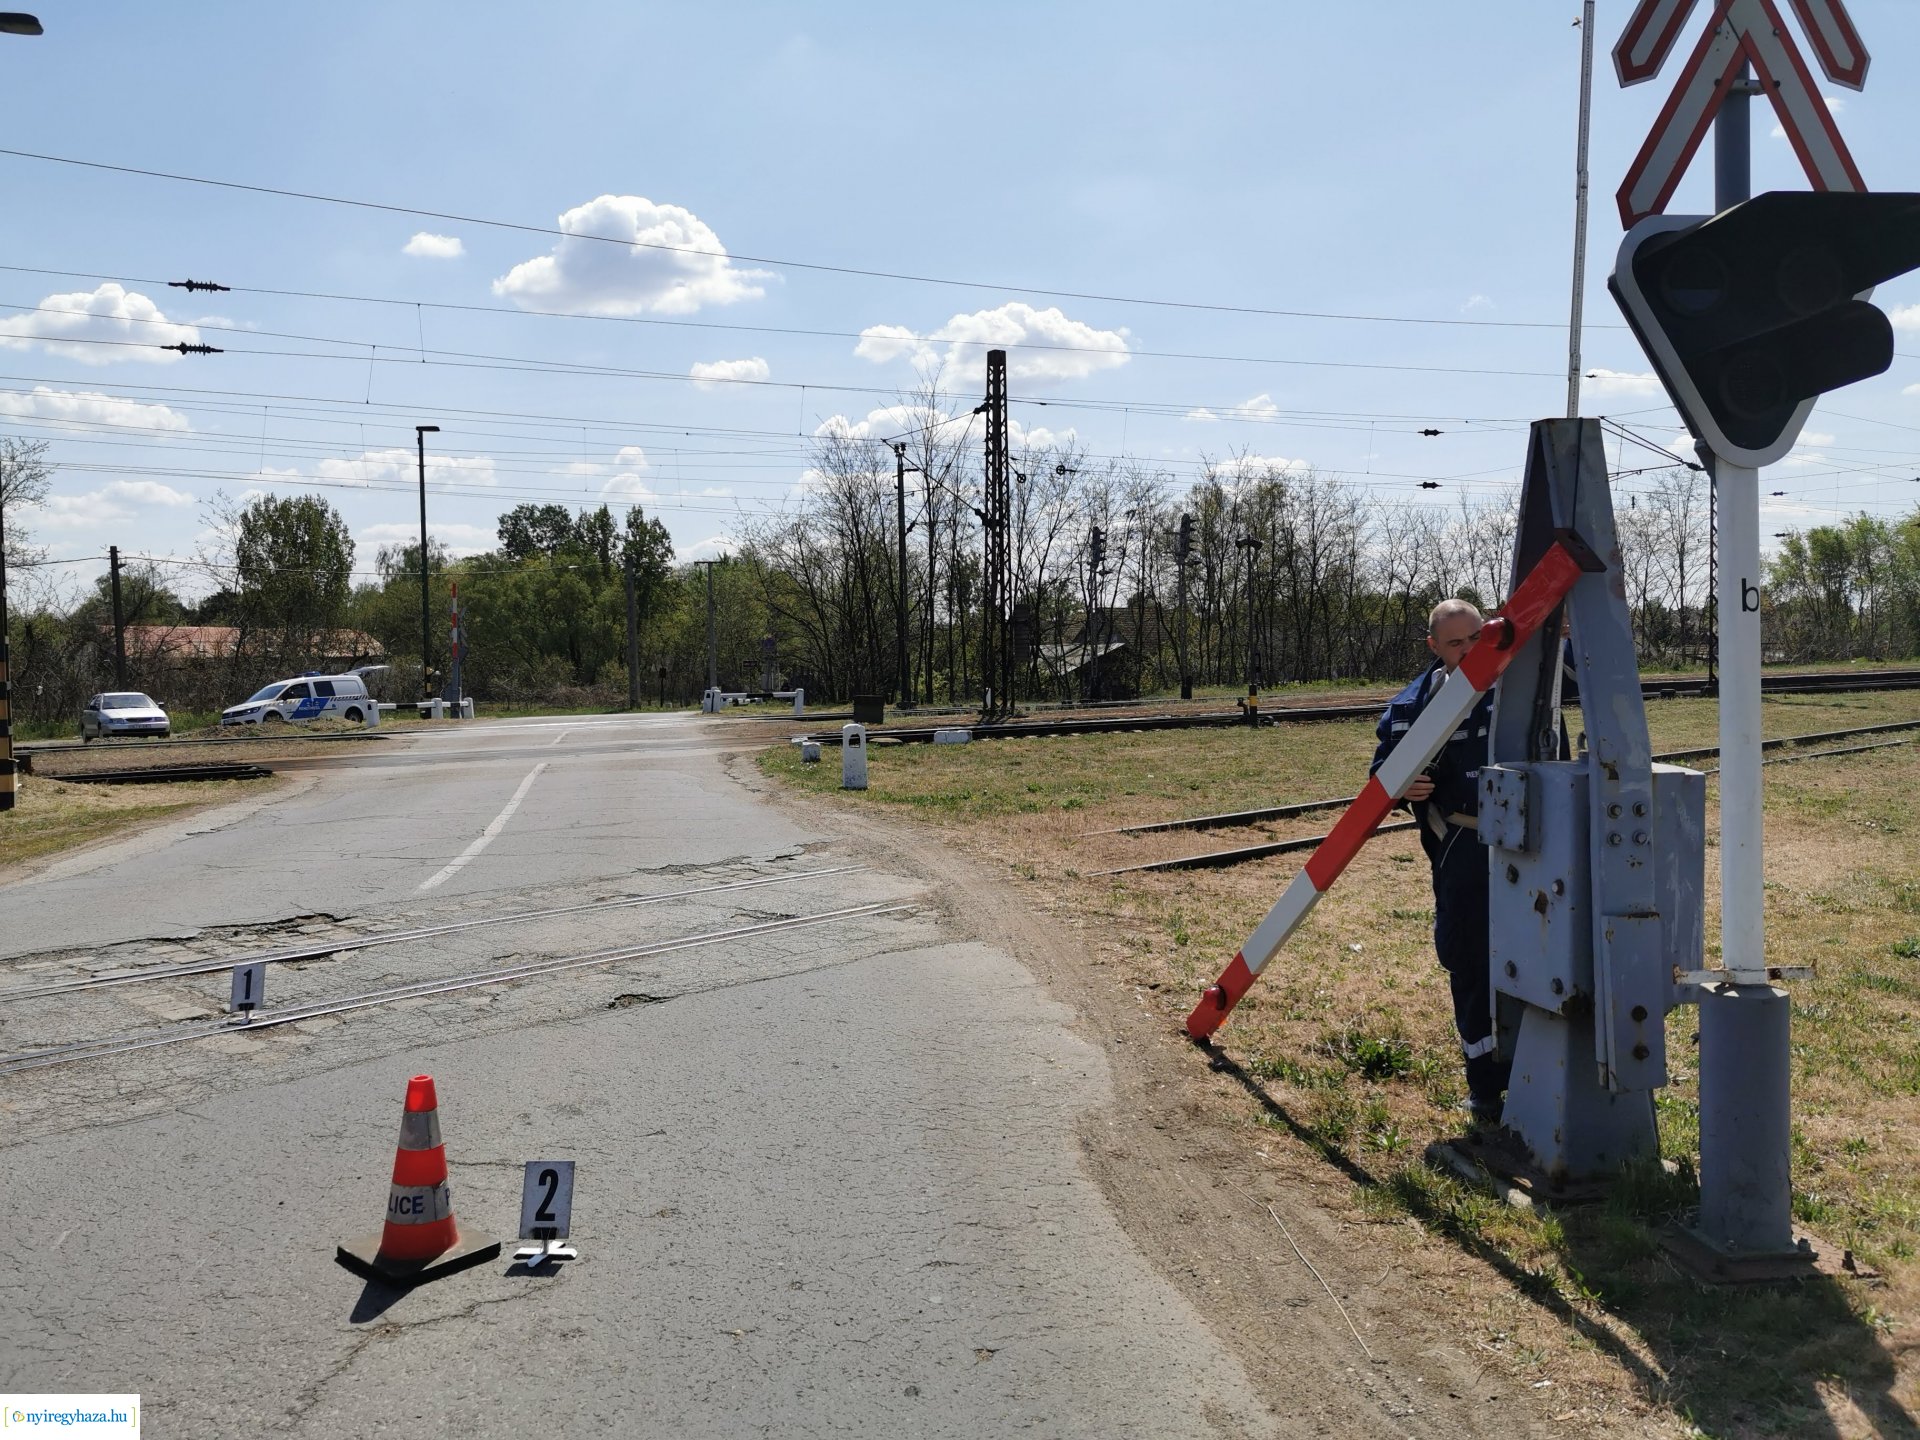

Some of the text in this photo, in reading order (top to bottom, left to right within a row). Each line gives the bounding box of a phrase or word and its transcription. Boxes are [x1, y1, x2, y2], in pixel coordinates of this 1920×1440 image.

[1742, 578, 1759, 612] b
[243, 968, 253, 1000] 1
[534, 1168, 559, 1222] 2
